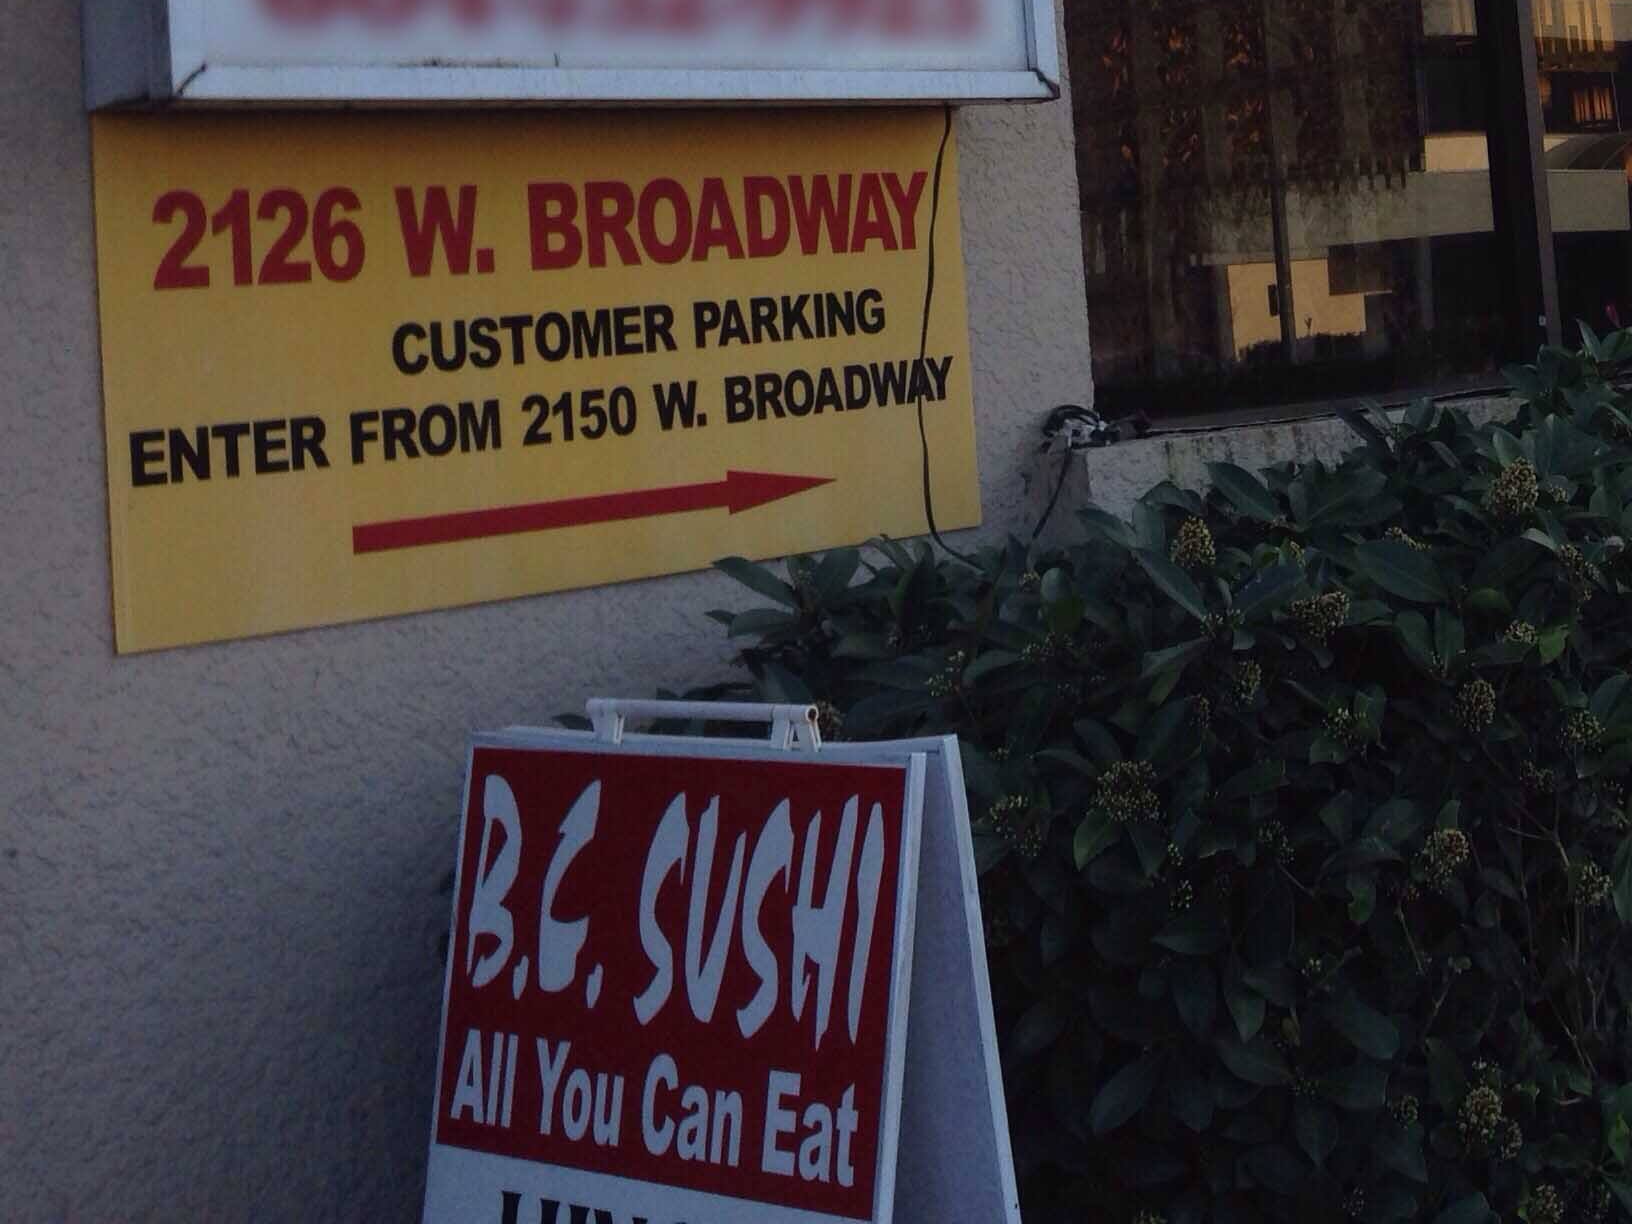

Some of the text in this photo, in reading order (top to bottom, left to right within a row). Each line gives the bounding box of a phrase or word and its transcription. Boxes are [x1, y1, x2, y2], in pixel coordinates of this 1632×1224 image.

[151, 171, 929, 291] 2126 W. BROADWAY
[391, 288, 886, 375] CUSTOMER PARKING
[129, 356, 953, 487] ENTER FROM 2150 W. BROADWAY
[466, 774, 884, 1051] B.C. SUSHI
[451, 1029, 859, 1188] All You Can Eat
